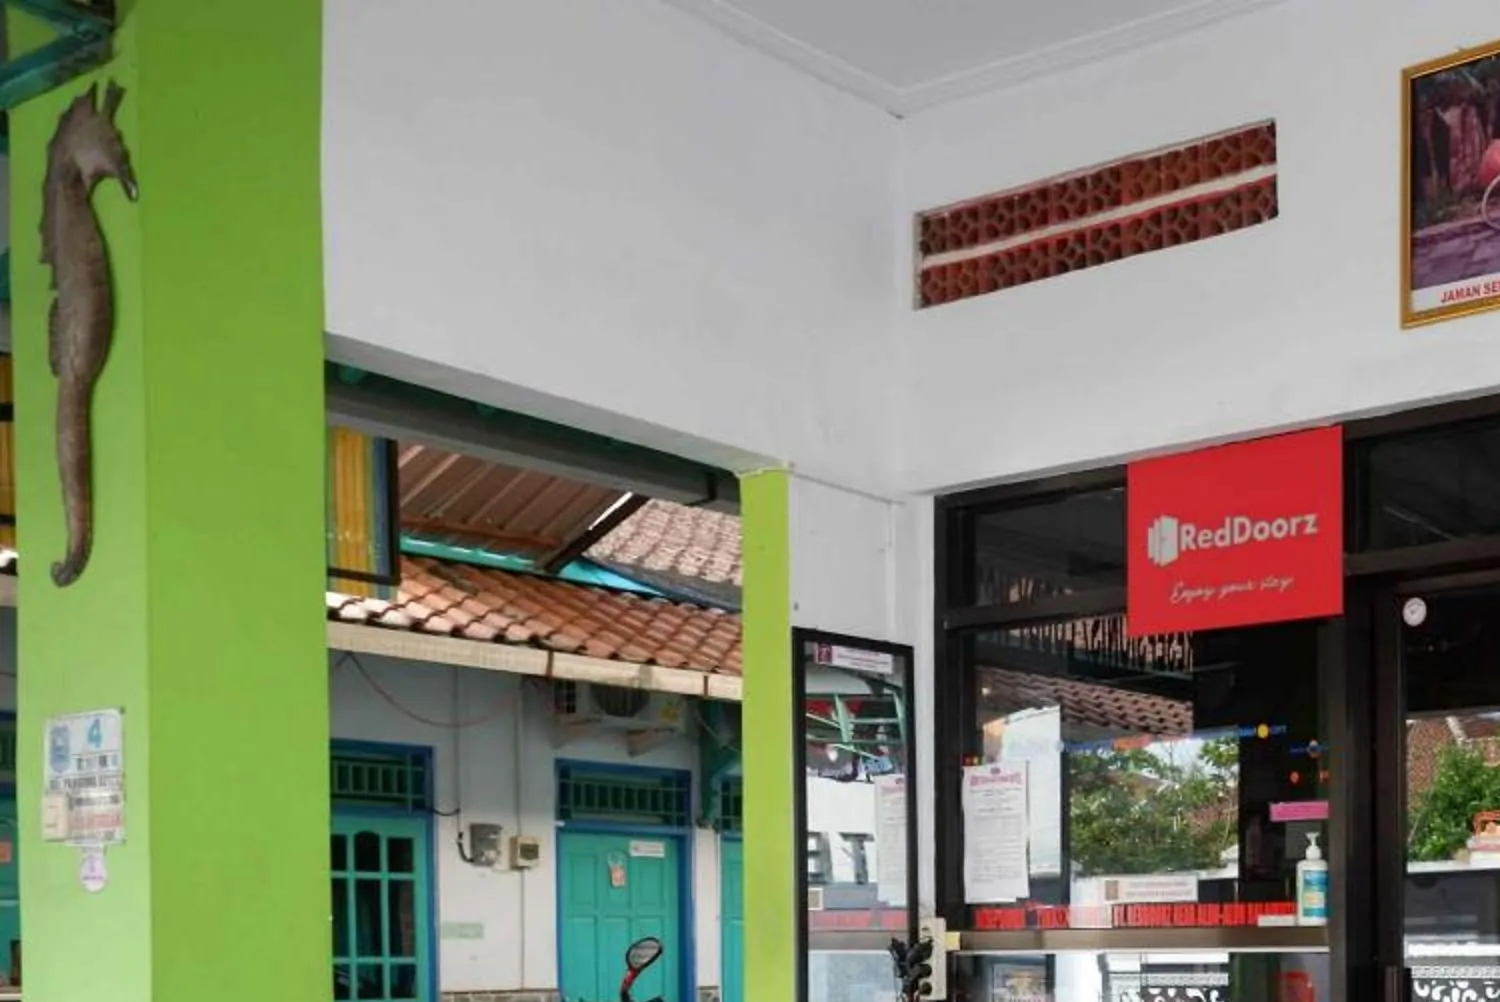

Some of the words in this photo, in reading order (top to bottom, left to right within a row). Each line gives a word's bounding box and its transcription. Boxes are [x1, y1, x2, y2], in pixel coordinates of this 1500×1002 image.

[1440, 286, 1481, 304] JAMAN
[1180, 512, 1319, 552] RedDoorz
[87, 718, 101, 748] 4
